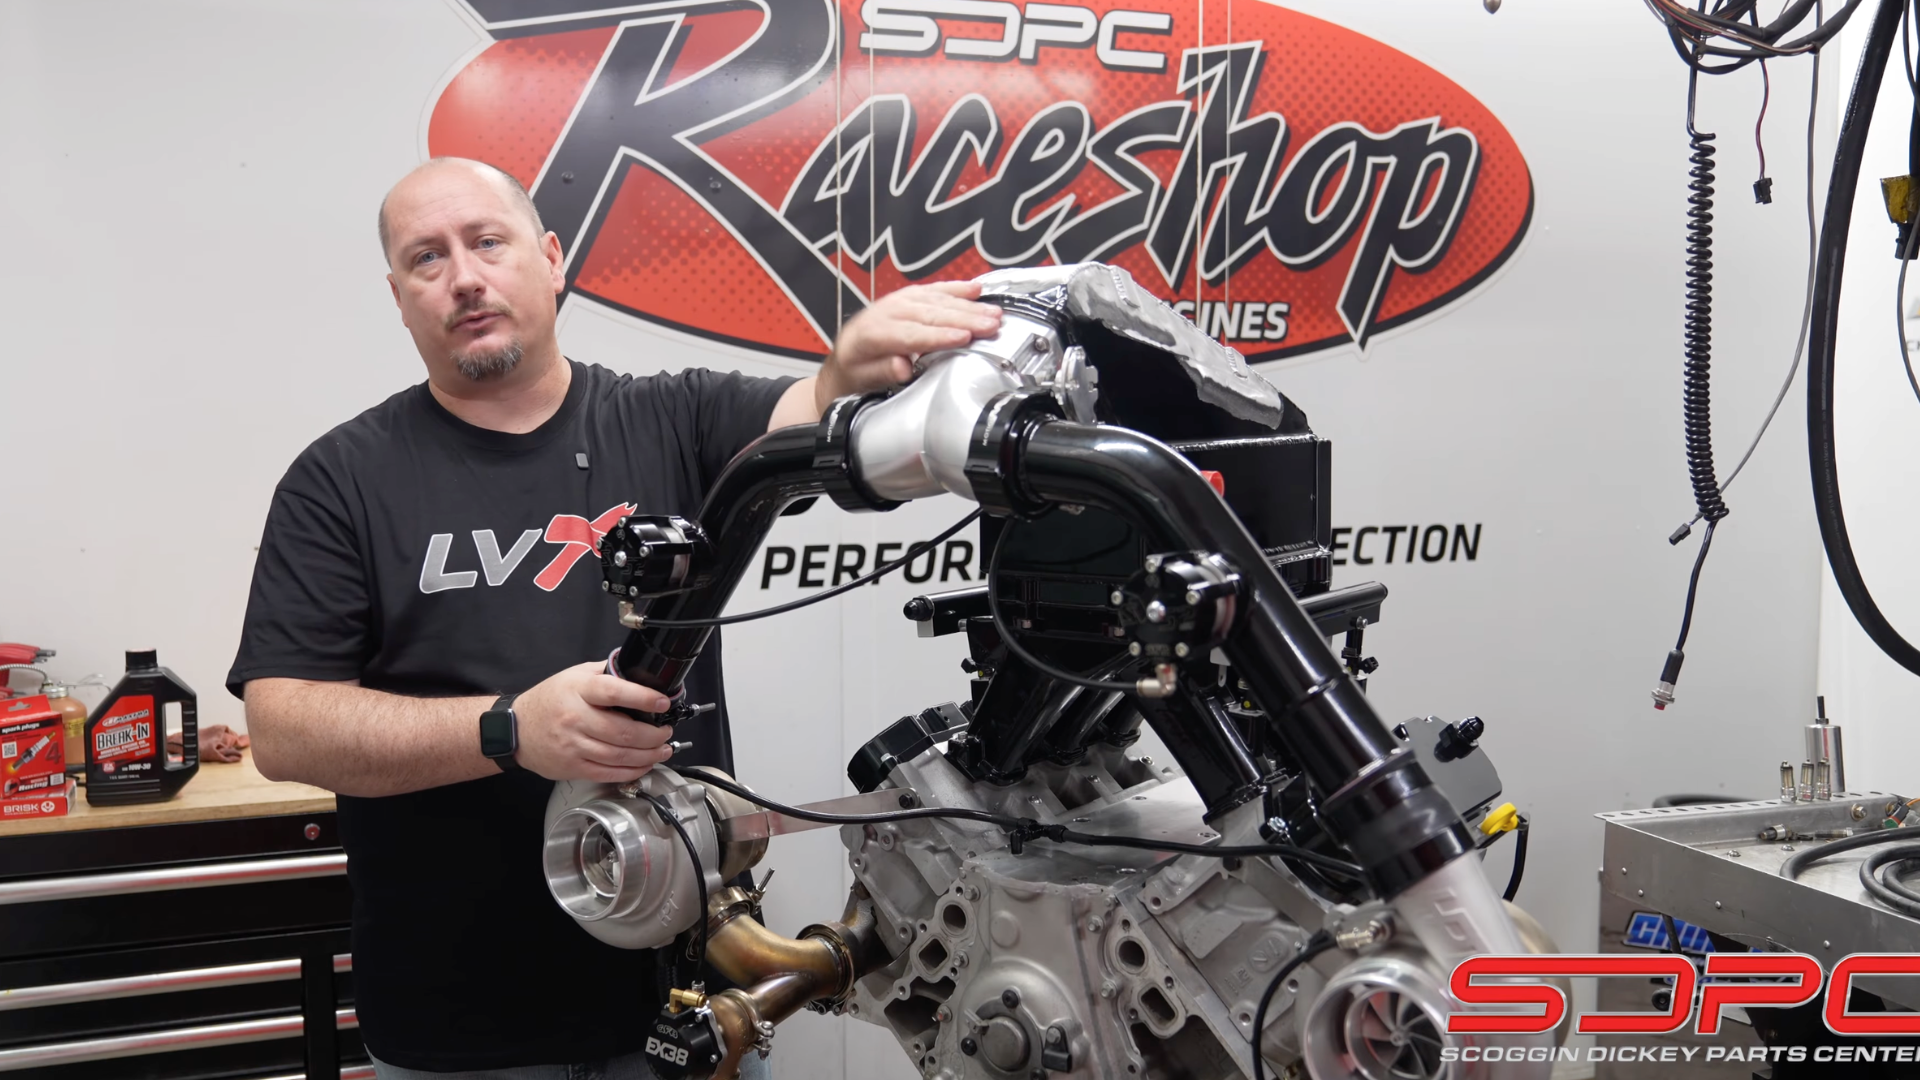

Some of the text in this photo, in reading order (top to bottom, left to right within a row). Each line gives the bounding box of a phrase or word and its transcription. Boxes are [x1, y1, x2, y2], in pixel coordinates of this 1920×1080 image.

[460, 0, 1480, 351] Raceshop
[760, 523, 1483, 590] PERFOR ECTION
[2, 722, 40, 734] spark plugs
[96, 722, 150, 751] BREAK-IN
[45, 741, 61, 765] 4
[3, 803, 40, 814] BRISK
[644, 1035, 690, 1067] EX38
